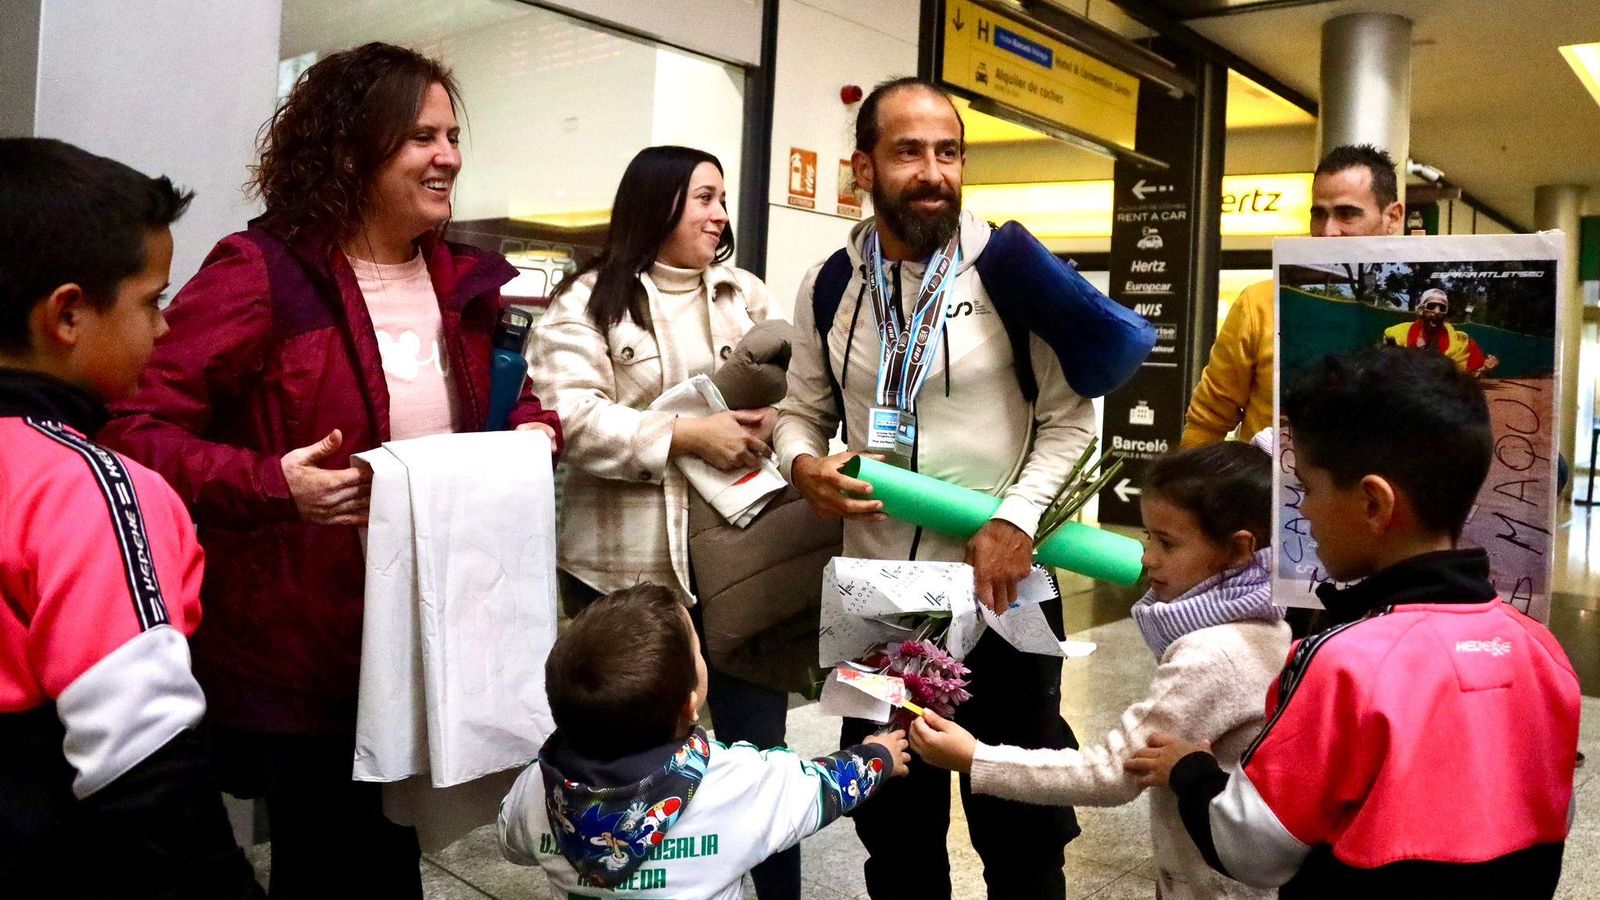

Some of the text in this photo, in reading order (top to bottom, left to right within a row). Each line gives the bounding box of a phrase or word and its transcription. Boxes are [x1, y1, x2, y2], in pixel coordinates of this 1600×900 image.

[995, 67, 1026, 89] Alquiler
[1028, 80, 1039, 94] de
[1039, 86, 1064, 104] coches
[1117, 210, 1187, 223] RENT A CAR
[1131, 260, 1167, 274] Hertz
[1125, 280, 1172, 292] Europcar
[1133, 303, 1163, 317] AVIS
[1113, 436, 1168, 452] Barceló
[648, 834, 718, 861] OSALIA
